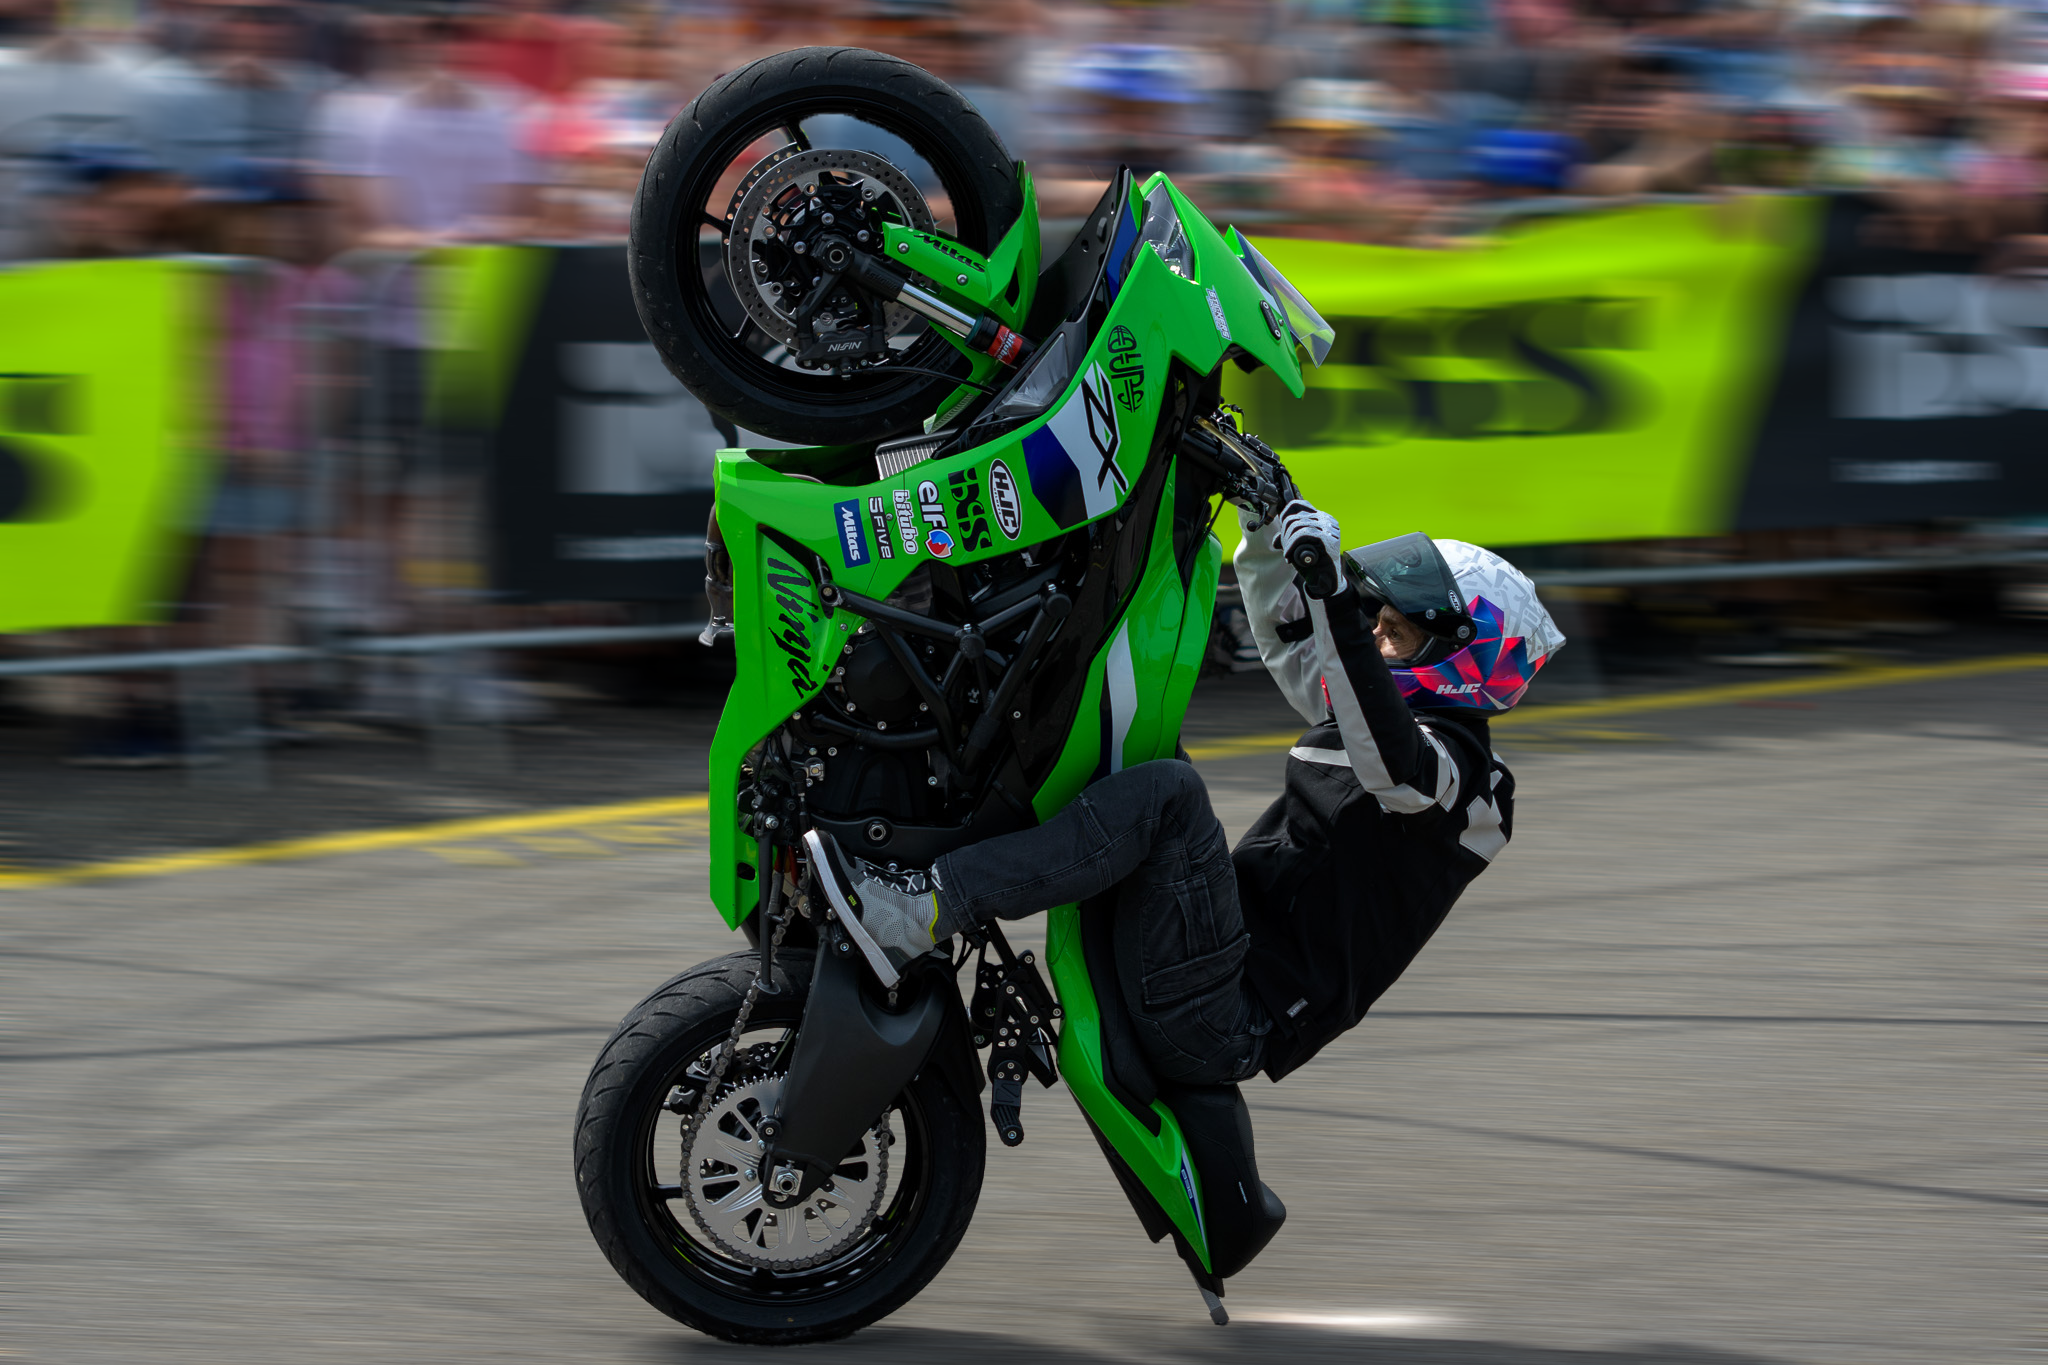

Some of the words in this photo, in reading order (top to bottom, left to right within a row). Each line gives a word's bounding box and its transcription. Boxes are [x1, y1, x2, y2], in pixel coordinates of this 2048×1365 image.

[913, 234, 986, 273] Mitas
[1081, 369, 1128, 494] ZX
[893, 490, 918, 554] bitubo
[917, 480, 949, 529] elf
[993, 470, 1019, 530] HJC
[841, 506, 861, 561] Mitas
[767, 557, 820, 700] Ninja
[1436, 683, 1481, 695] HJC
